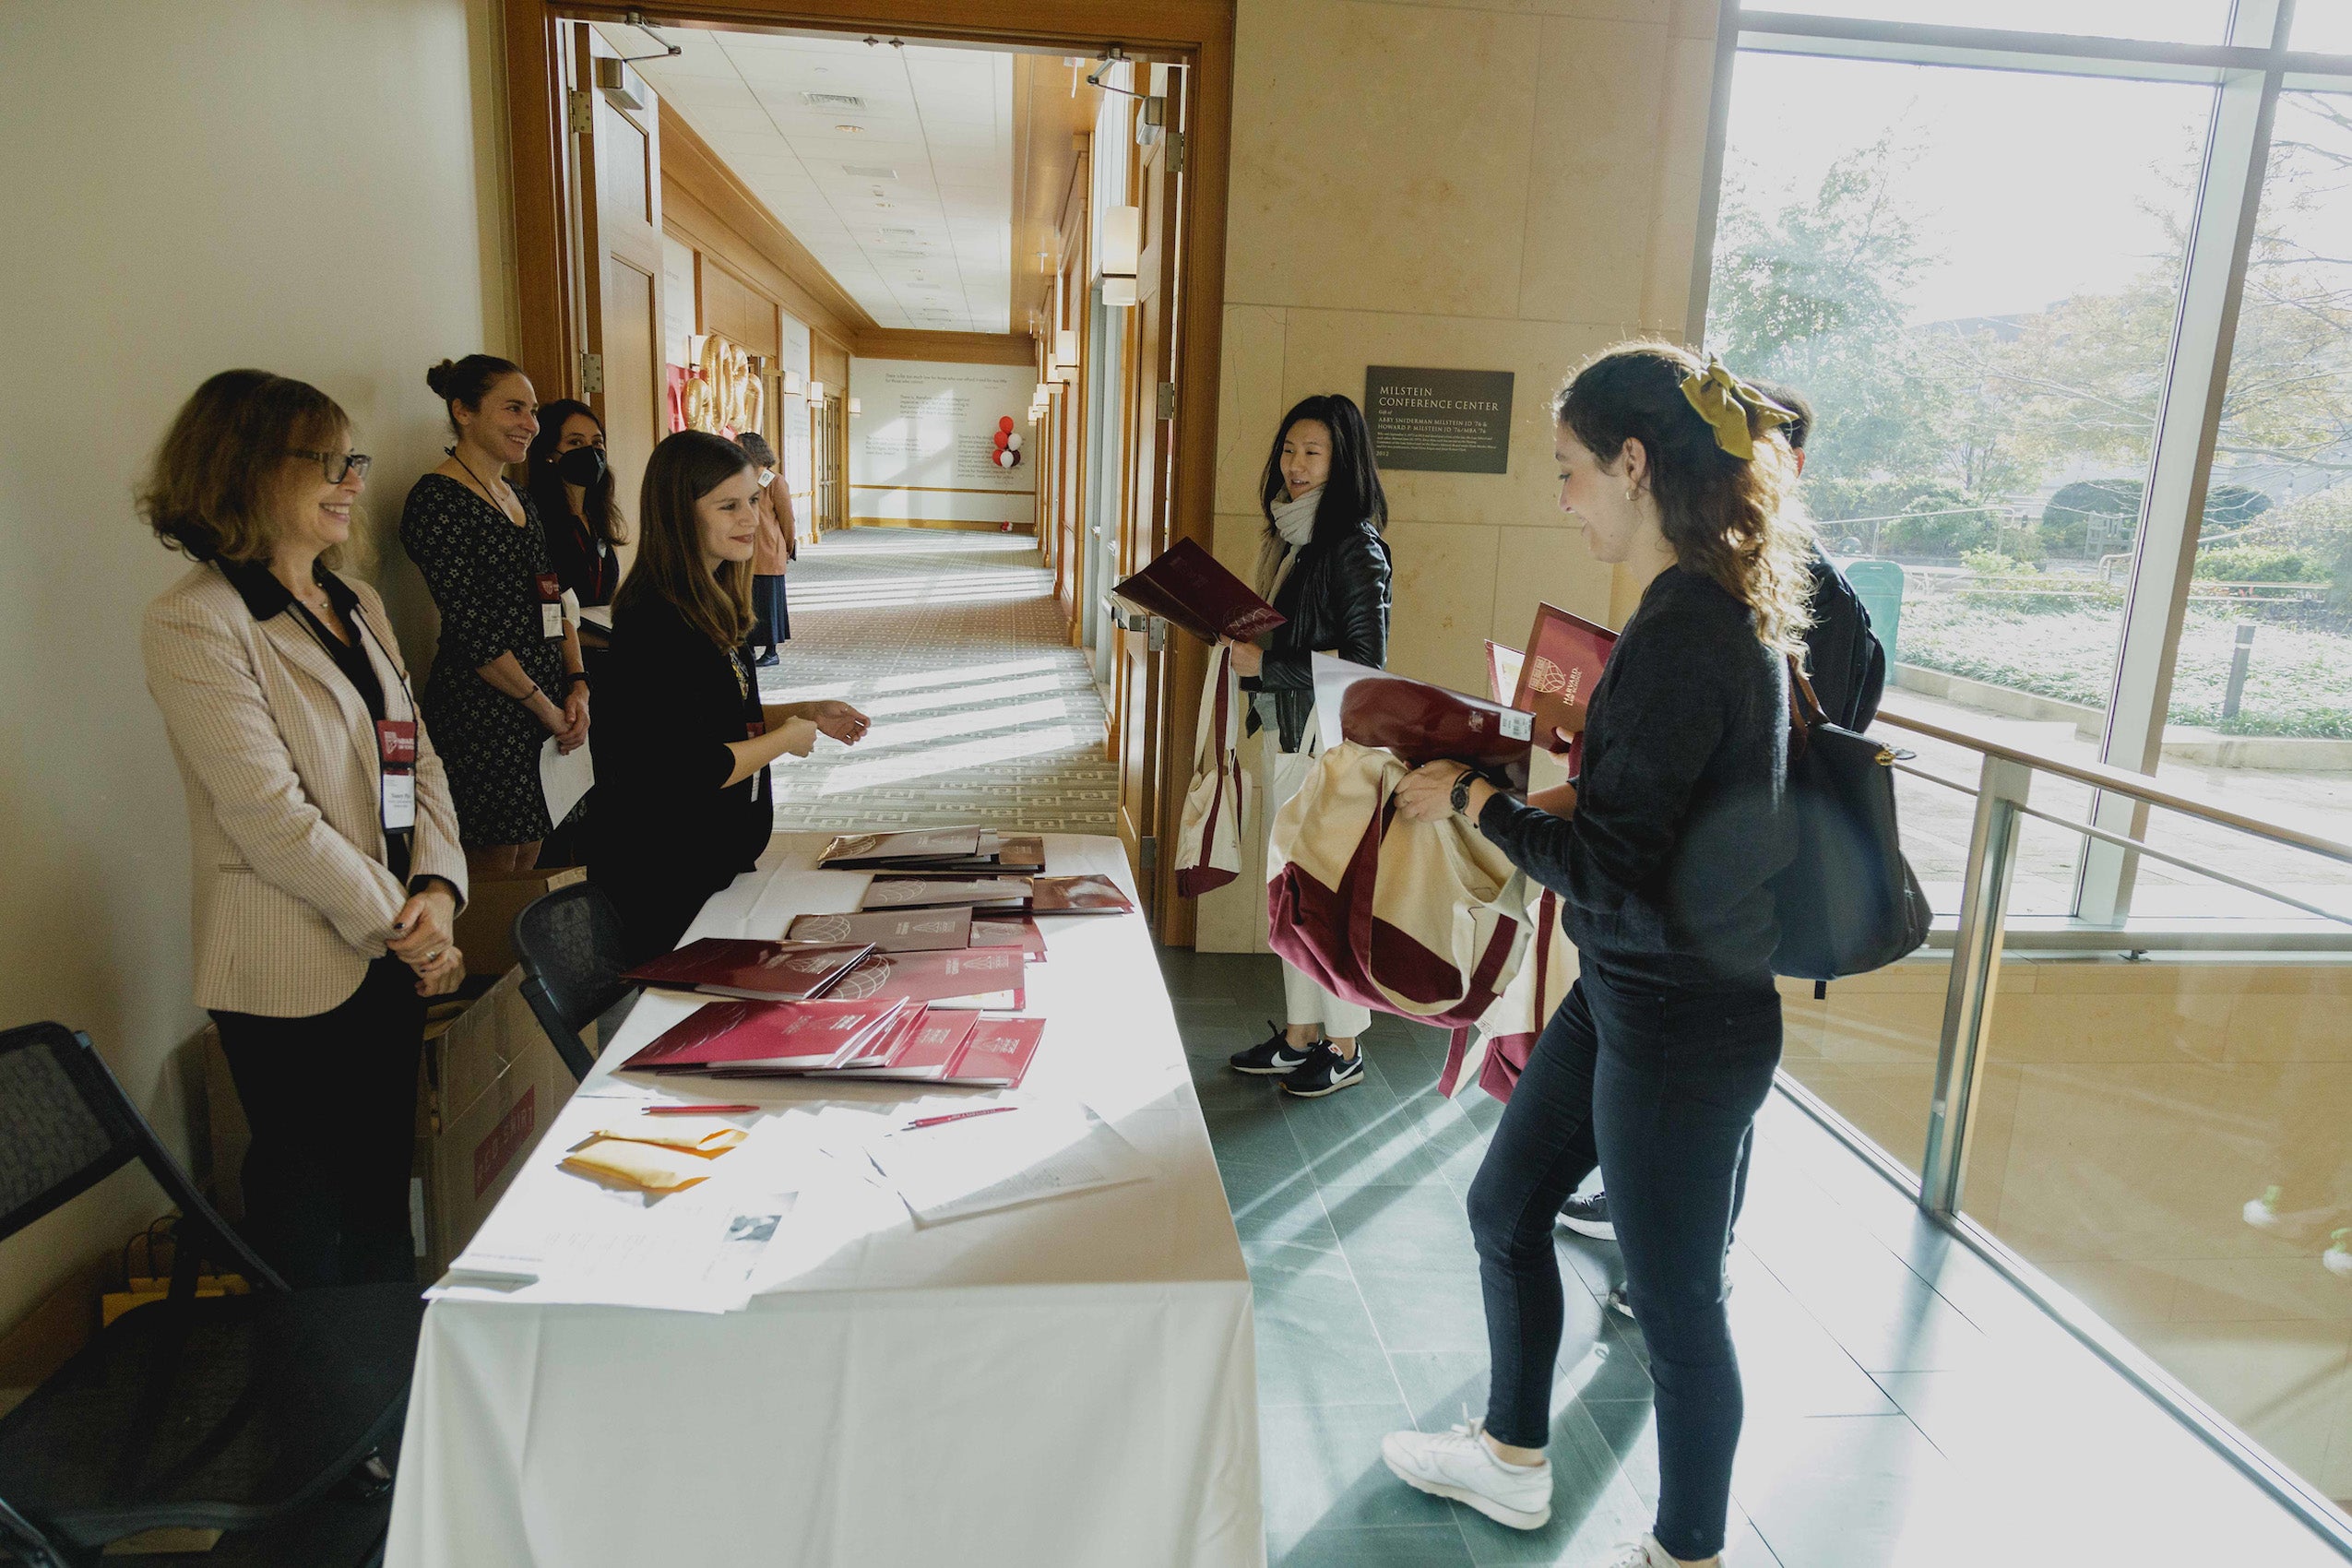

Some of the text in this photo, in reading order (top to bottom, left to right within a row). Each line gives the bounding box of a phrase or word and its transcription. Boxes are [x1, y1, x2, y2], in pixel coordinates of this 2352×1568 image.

[1380, 386, 1432, 397] MILSTEIN
[1379, 398, 1499, 411] CONFERENCE CENTER
[1562, 667, 1578, 704] HARVARD
[501, 1105, 532, 1145] SHIRT
